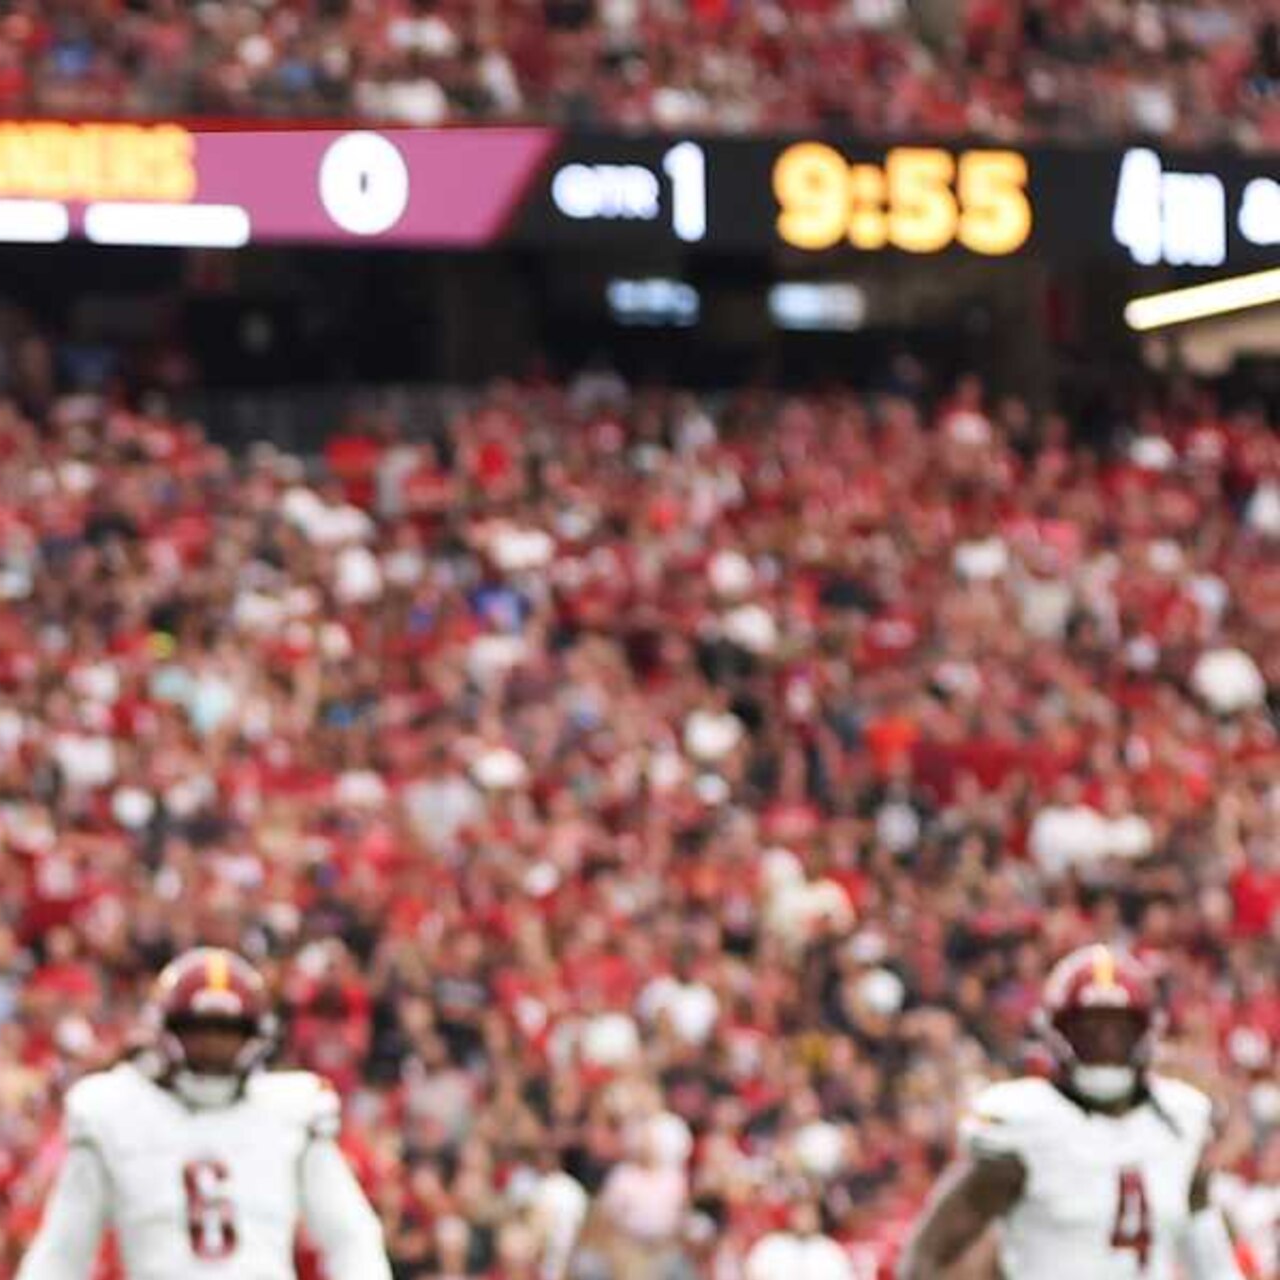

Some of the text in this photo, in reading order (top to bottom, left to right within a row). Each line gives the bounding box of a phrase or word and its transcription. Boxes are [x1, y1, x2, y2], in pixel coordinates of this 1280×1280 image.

[662, 140, 707, 243] 1
[772, 141, 1033, 256] 9:55
[180, 1155, 238, 1264] 6
[1109, 1166, 1154, 1272] 4
